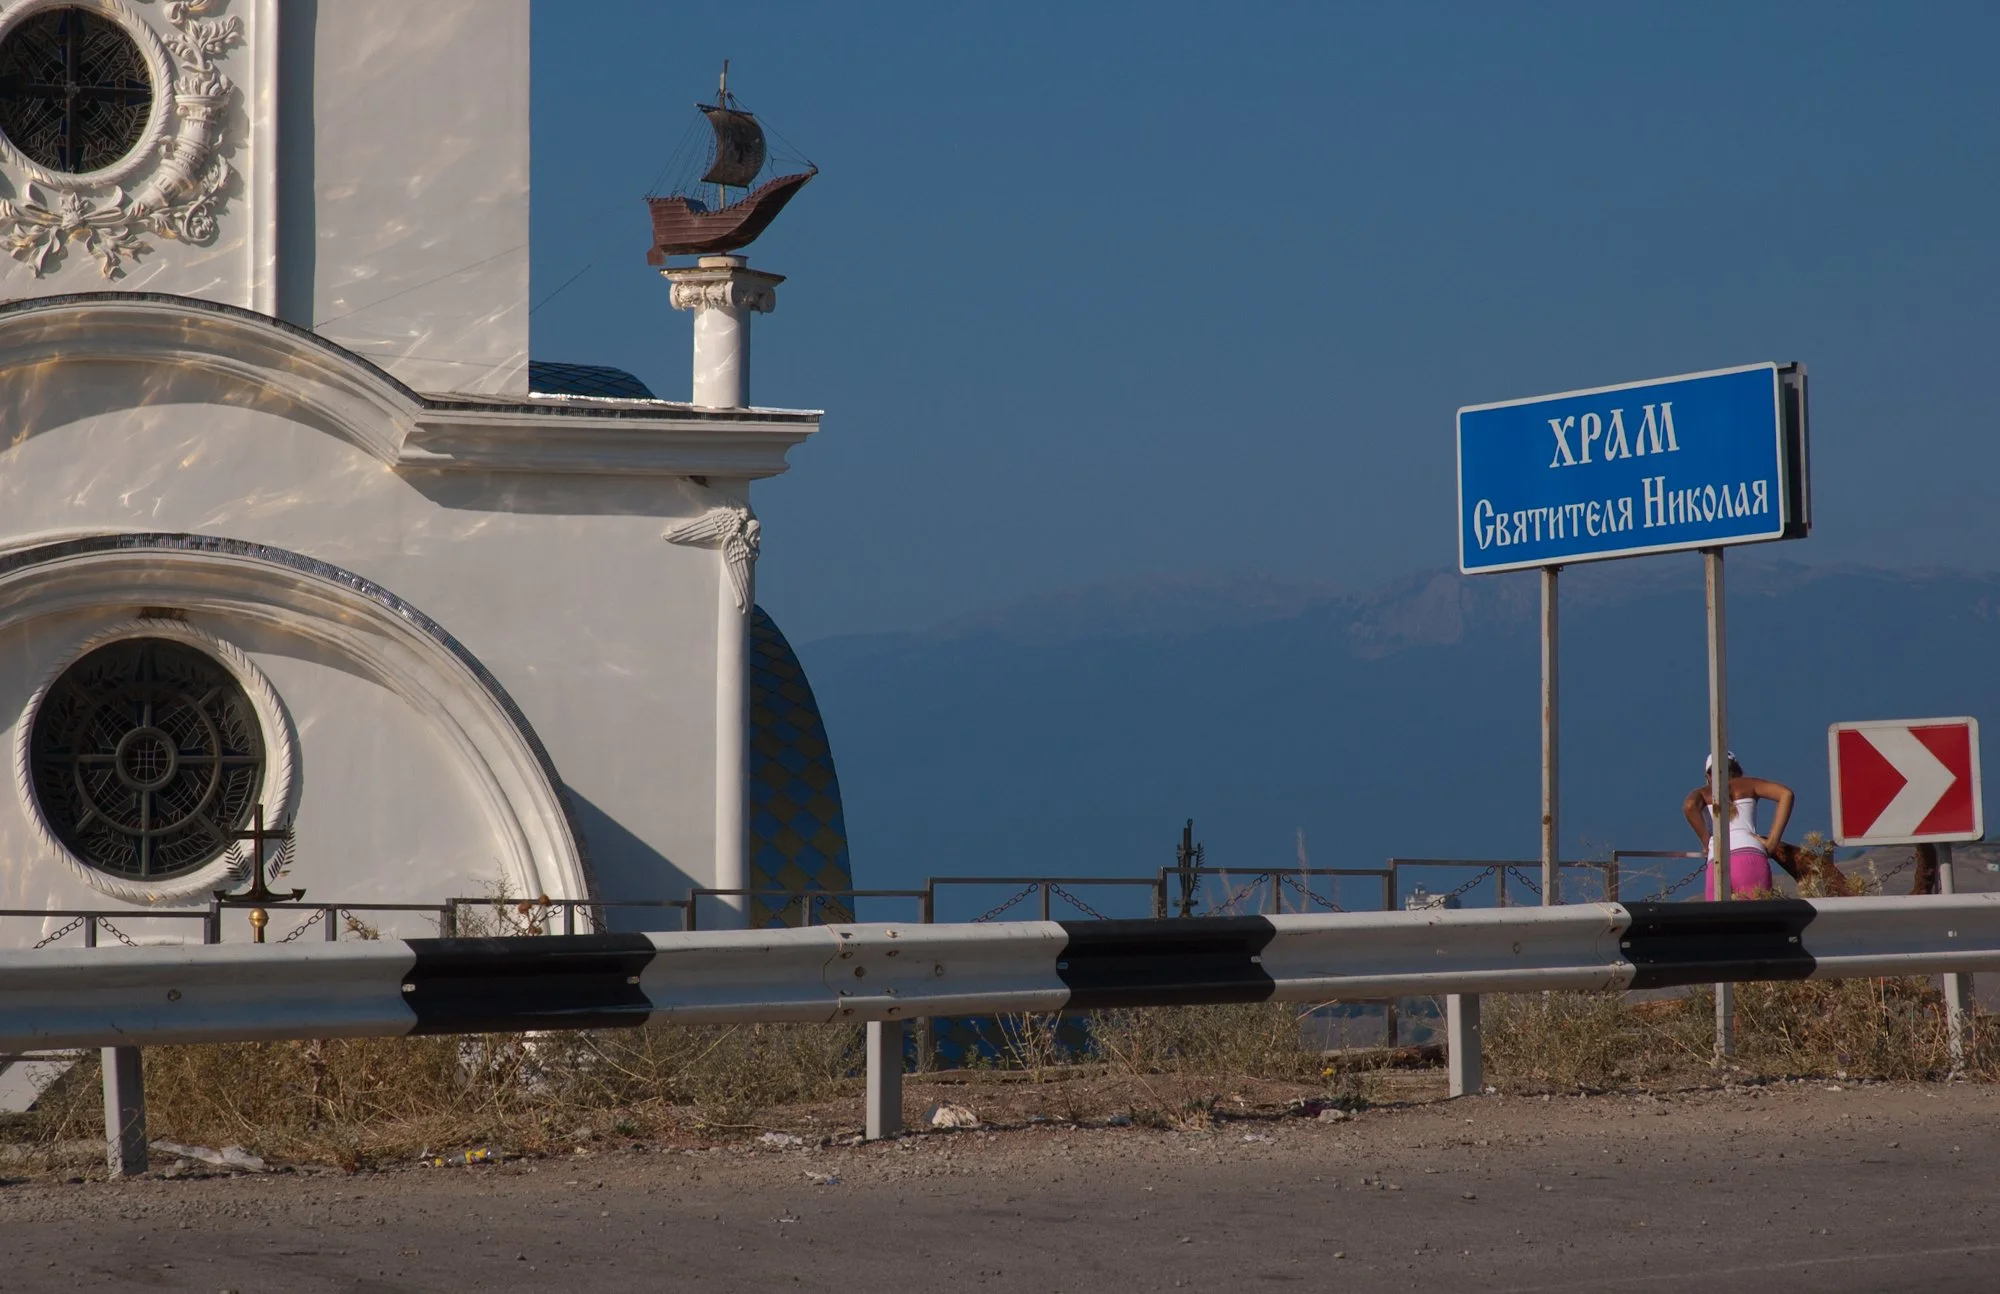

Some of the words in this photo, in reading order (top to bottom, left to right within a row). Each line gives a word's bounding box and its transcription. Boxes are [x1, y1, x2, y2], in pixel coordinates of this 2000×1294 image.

[1547, 401, 1680, 469] ХРАМ
[1472, 496, 1633, 550] Святителя
[1641, 475, 1769, 529] Николая
